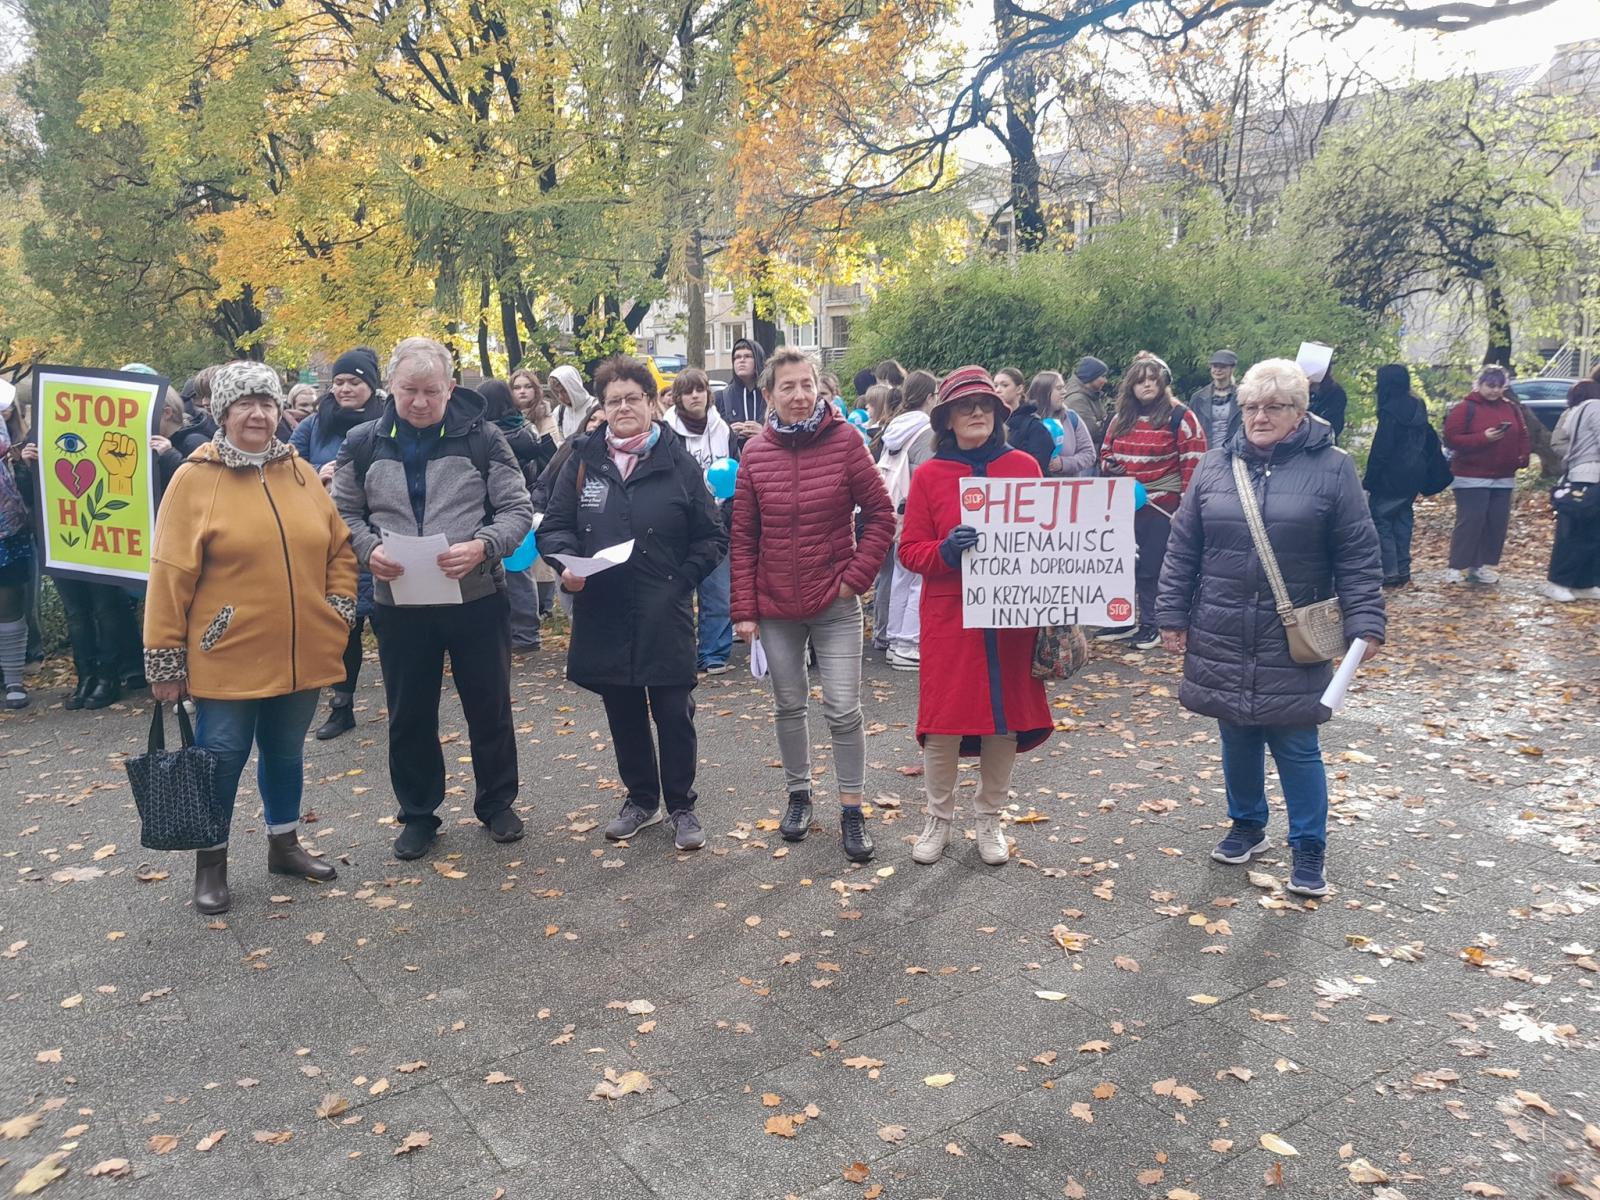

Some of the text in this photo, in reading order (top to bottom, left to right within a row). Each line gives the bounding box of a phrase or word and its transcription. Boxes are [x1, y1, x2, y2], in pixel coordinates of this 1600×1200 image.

[55, 391, 139, 427] STOP
[964, 494, 983, 504] STOP
[984, 480, 1094, 531] HEJT
[970, 556, 1124, 576] KTÓRA DOPROWADZA
[967, 585, 1107, 606] DO KRZYWDZENIA
[992, 606, 1079, 626] INNYCH
[1109, 603, 1129, 615] STOP
